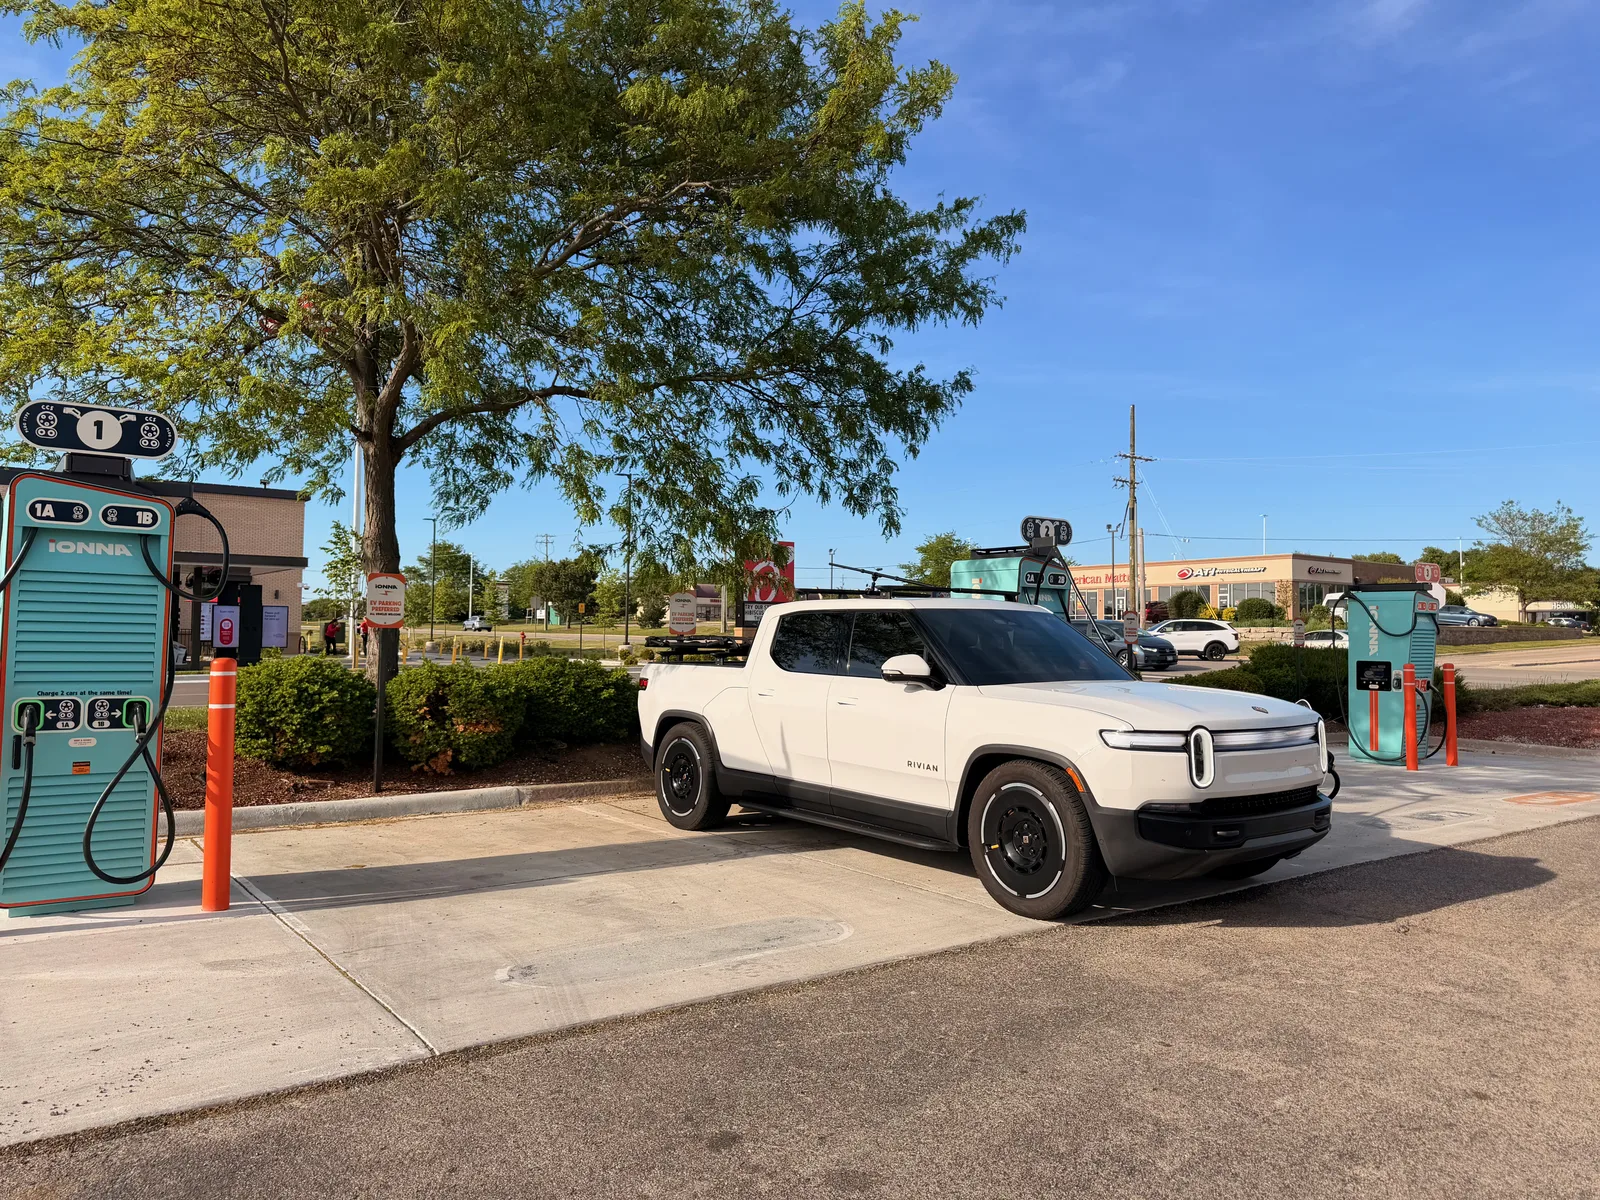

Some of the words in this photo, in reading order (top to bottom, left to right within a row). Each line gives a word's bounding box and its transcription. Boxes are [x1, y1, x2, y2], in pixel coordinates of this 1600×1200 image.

[93, 420, 104, 441] 1
[35, 503, 56, 518] 1A
[136, 511, 154, 525] 1B
[1044, 525, 1050, 537] 2
[1026, 573, 1035, 583] 2A
[1193, 567, 1217, 577] ATI
[1425, 567, 1430, 578] 3
[1057, 575, 1066, 584] 2B
[907, 760, 939, 772] RIVIAN
